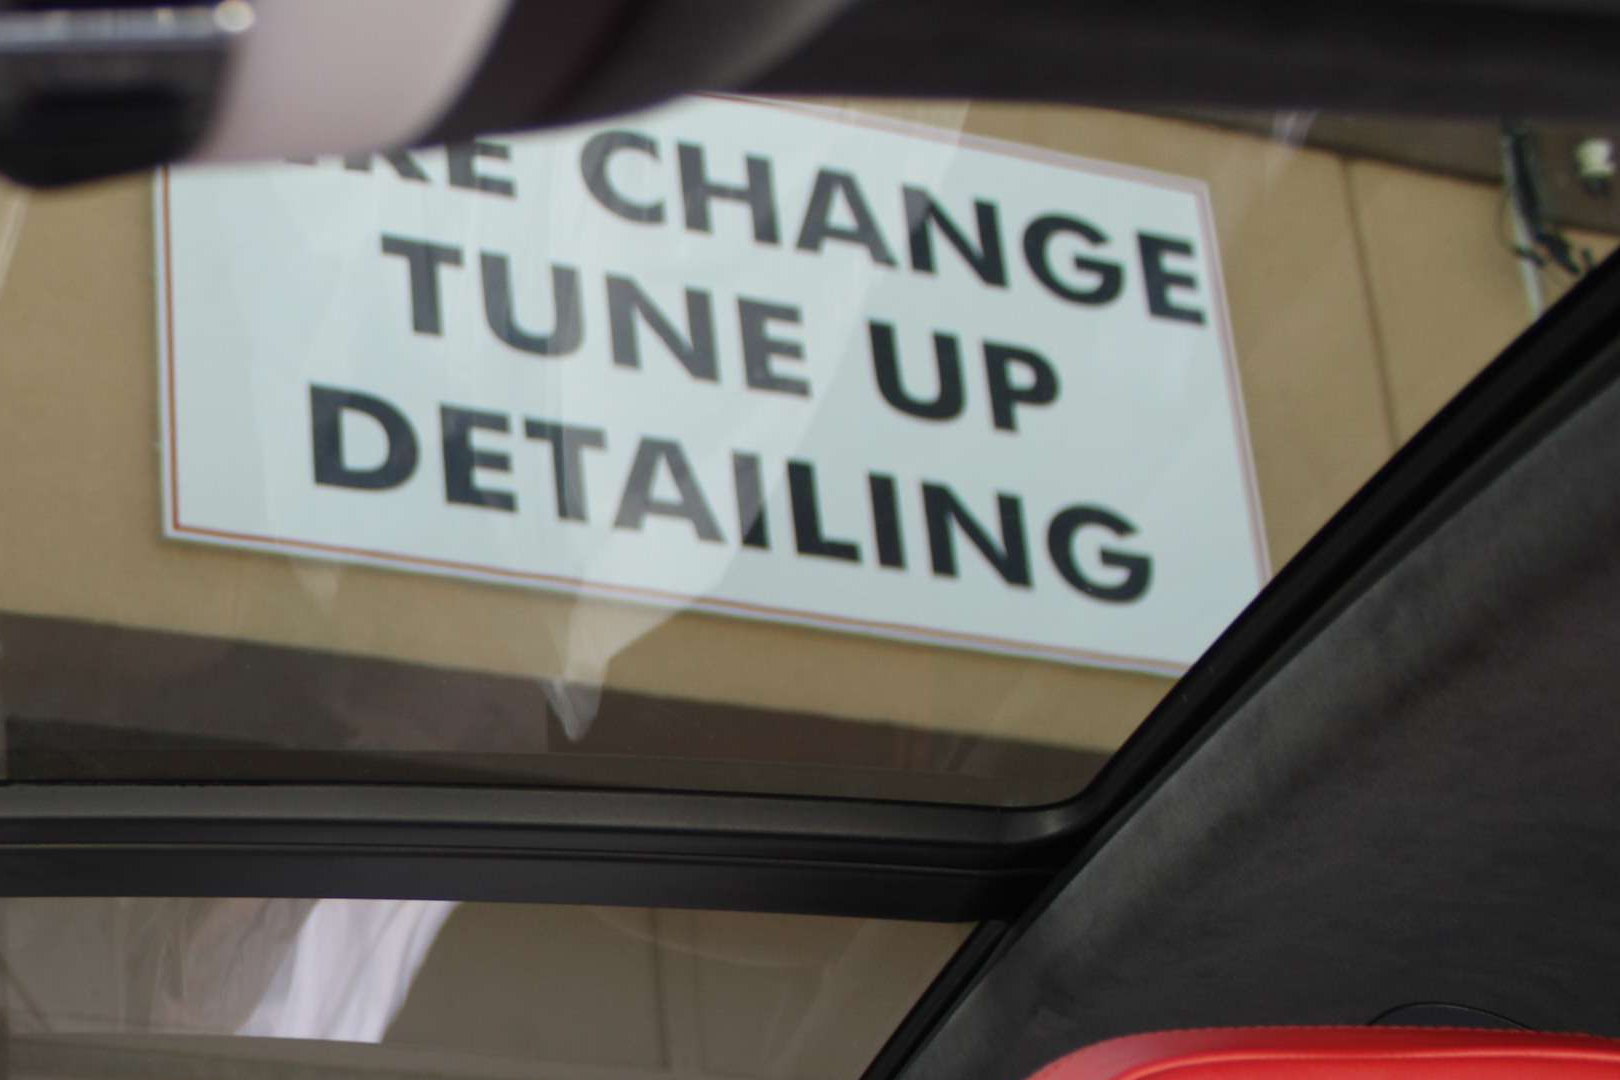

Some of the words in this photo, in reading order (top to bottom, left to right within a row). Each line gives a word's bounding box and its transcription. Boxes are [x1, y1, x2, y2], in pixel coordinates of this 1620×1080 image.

[581, 130, 1206, 325] CHANGE
[381, 233, 811, 398] TUNE
[869, 319, 1060, 433] UP
[308, 383, 1153, 604] DETAILING
